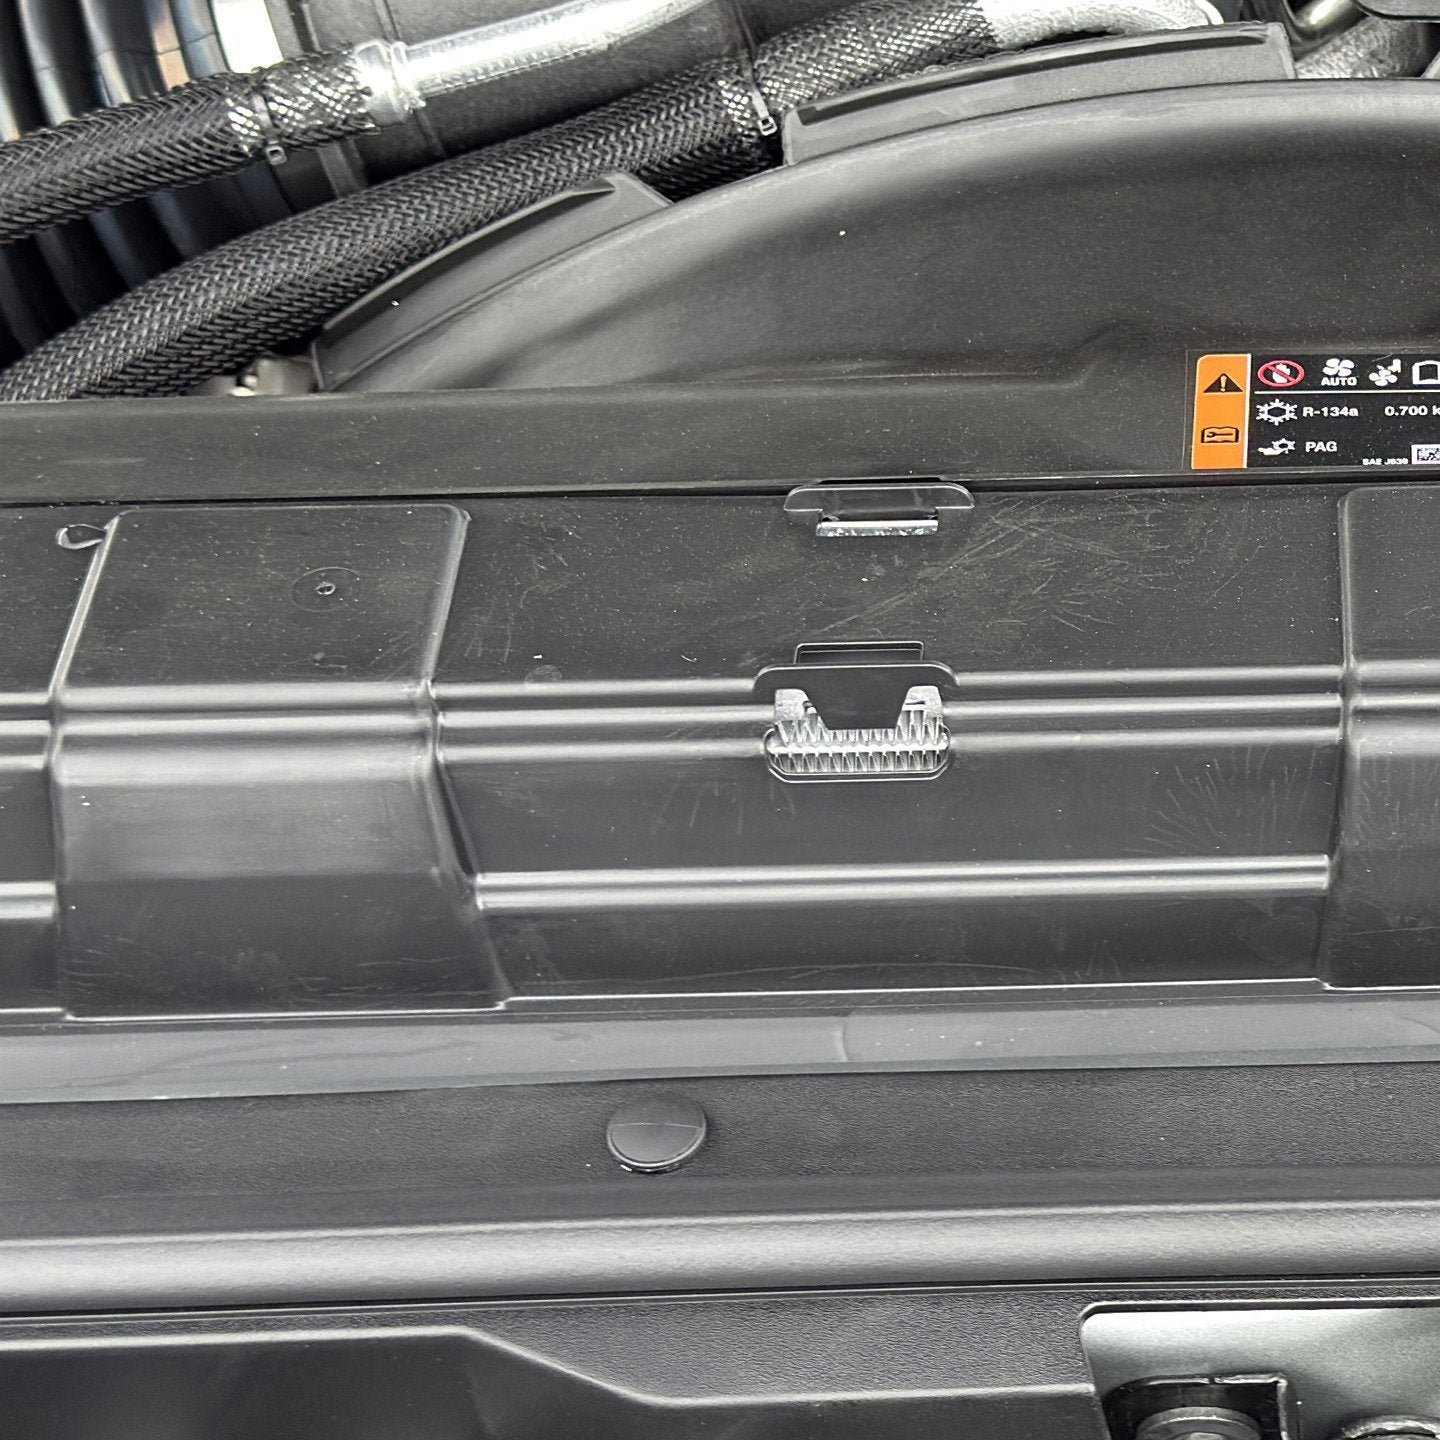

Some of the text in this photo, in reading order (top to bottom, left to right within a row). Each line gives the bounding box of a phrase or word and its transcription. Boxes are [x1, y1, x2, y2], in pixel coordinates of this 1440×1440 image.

[1320, 376, 1358, 386] AUTO
[1302, 406, 1359, 417] R-134a
[1384, 406, 1428, 417] 0.700
[1305, 441, 1338, 452] PAG
